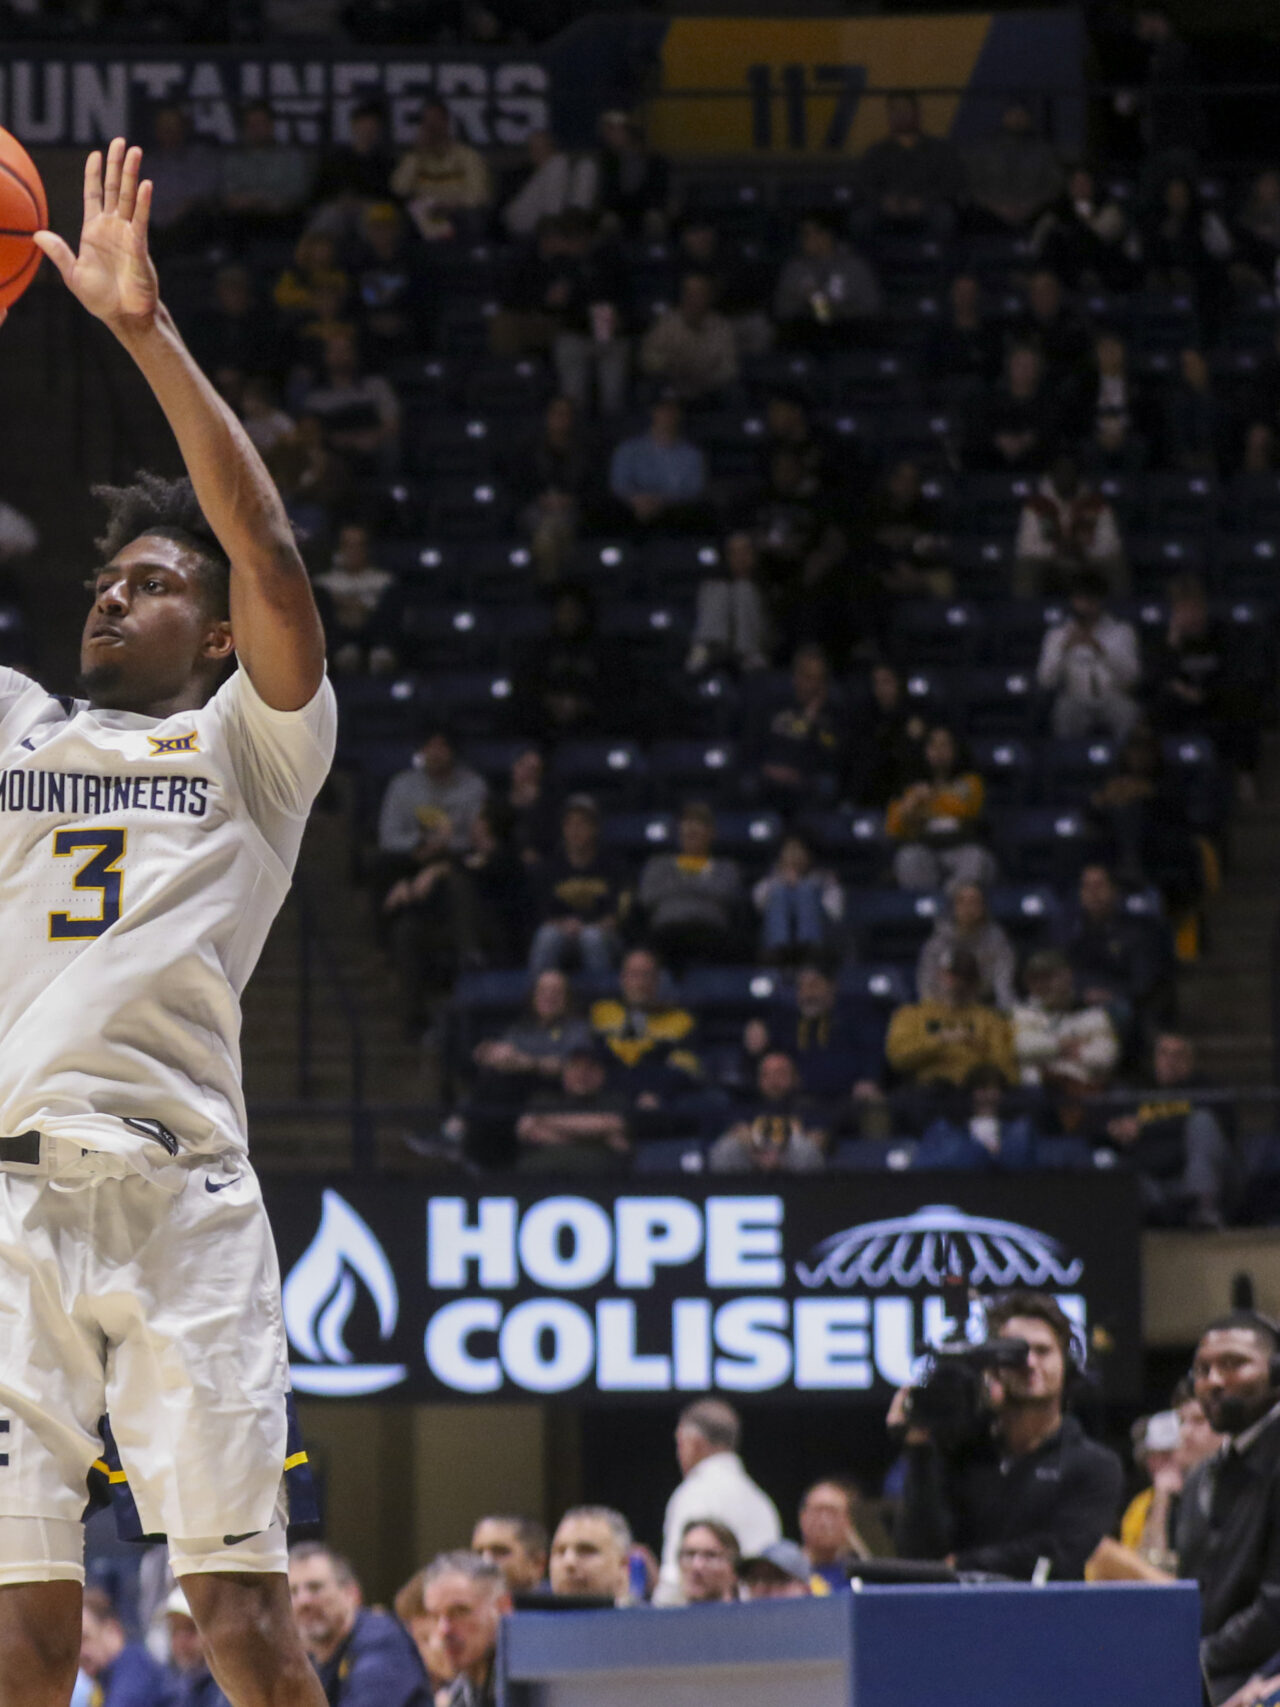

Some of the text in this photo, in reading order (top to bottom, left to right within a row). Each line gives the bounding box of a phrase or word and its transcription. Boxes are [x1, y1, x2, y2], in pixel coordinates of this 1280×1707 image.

[747, 65, 867, 148] 117
[48, 827, 127, 942] 3
[427, 1196, 785, 1289] HOPE
[425, 1295, 1087, 1392] COLISEU
